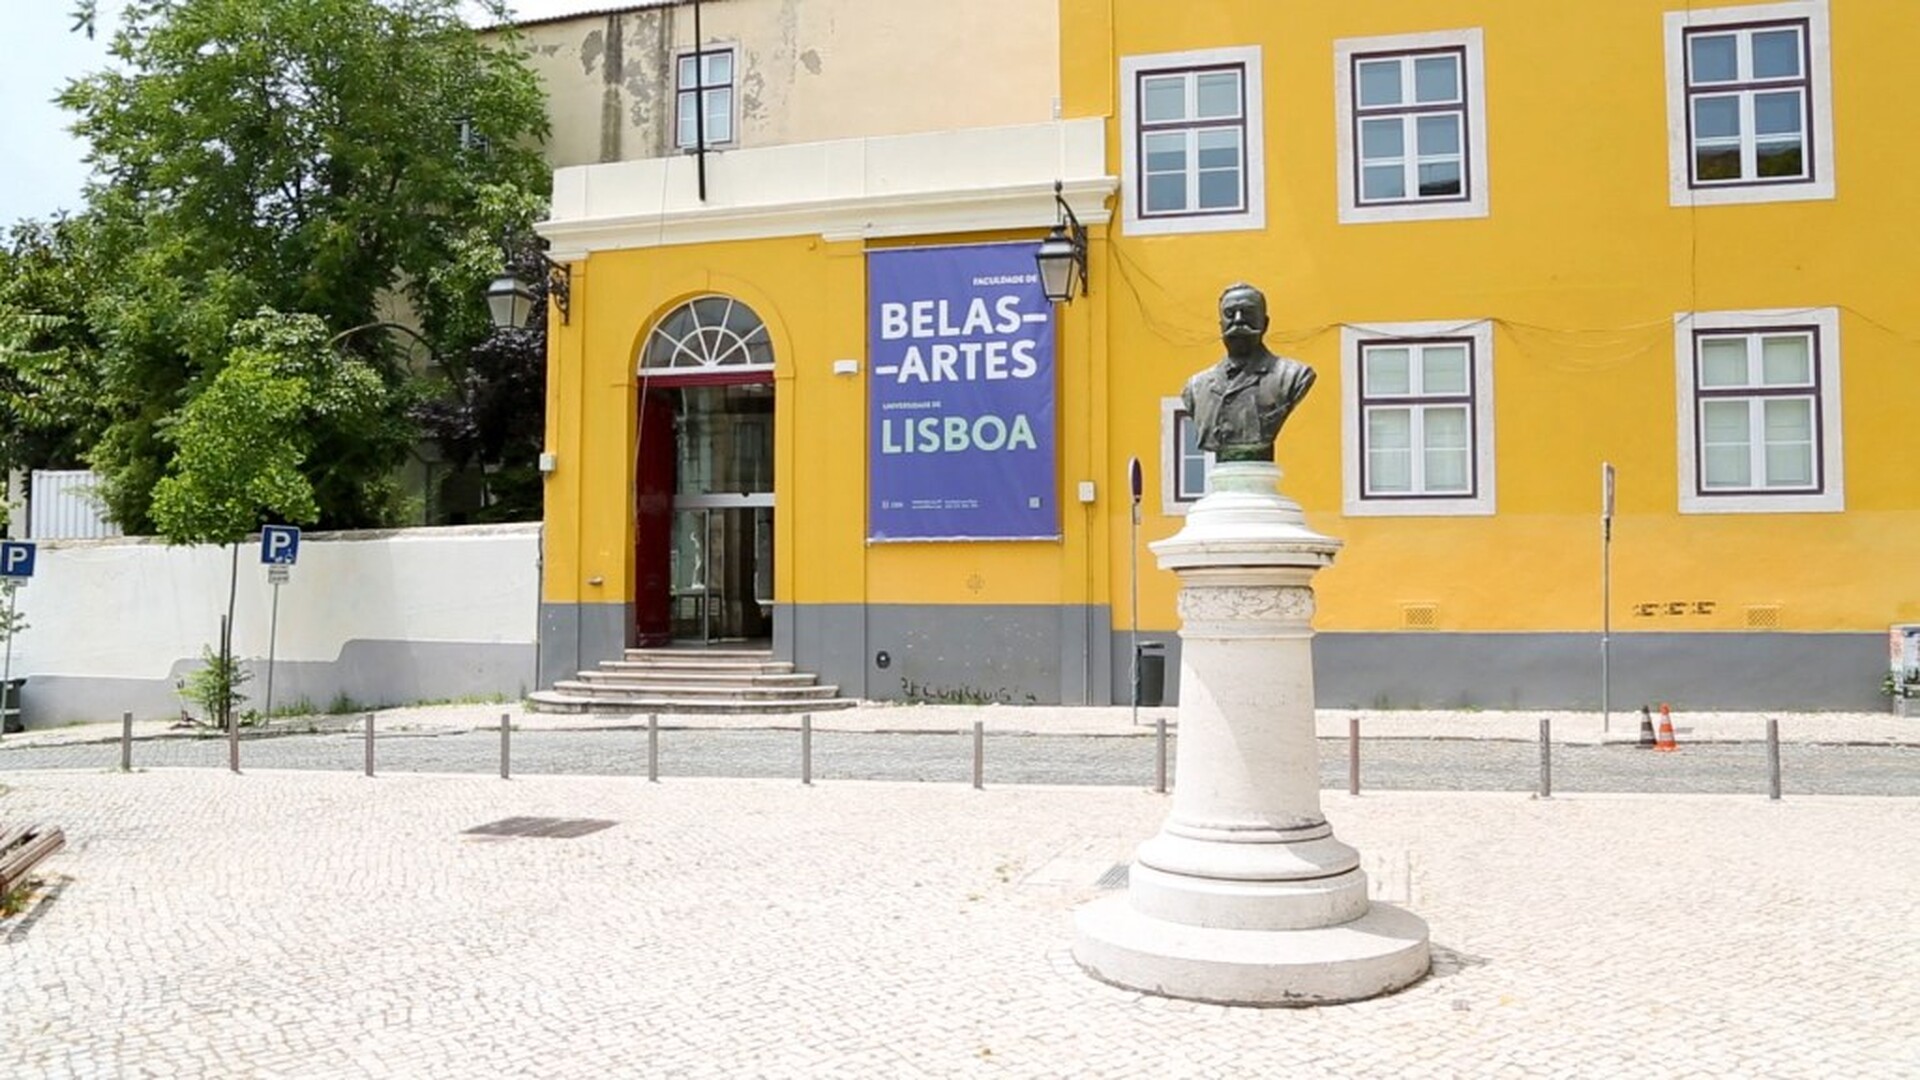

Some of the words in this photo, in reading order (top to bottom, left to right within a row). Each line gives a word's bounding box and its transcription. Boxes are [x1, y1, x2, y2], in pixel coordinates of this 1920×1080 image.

[972, 274, 1024, 286] FACULDADE
[1025, 273, 1037, 284] DE
[882, 414, 1037, 454] LISBOA
[269, 531, 291, 558] P
[7, 546, 28, 572] P
